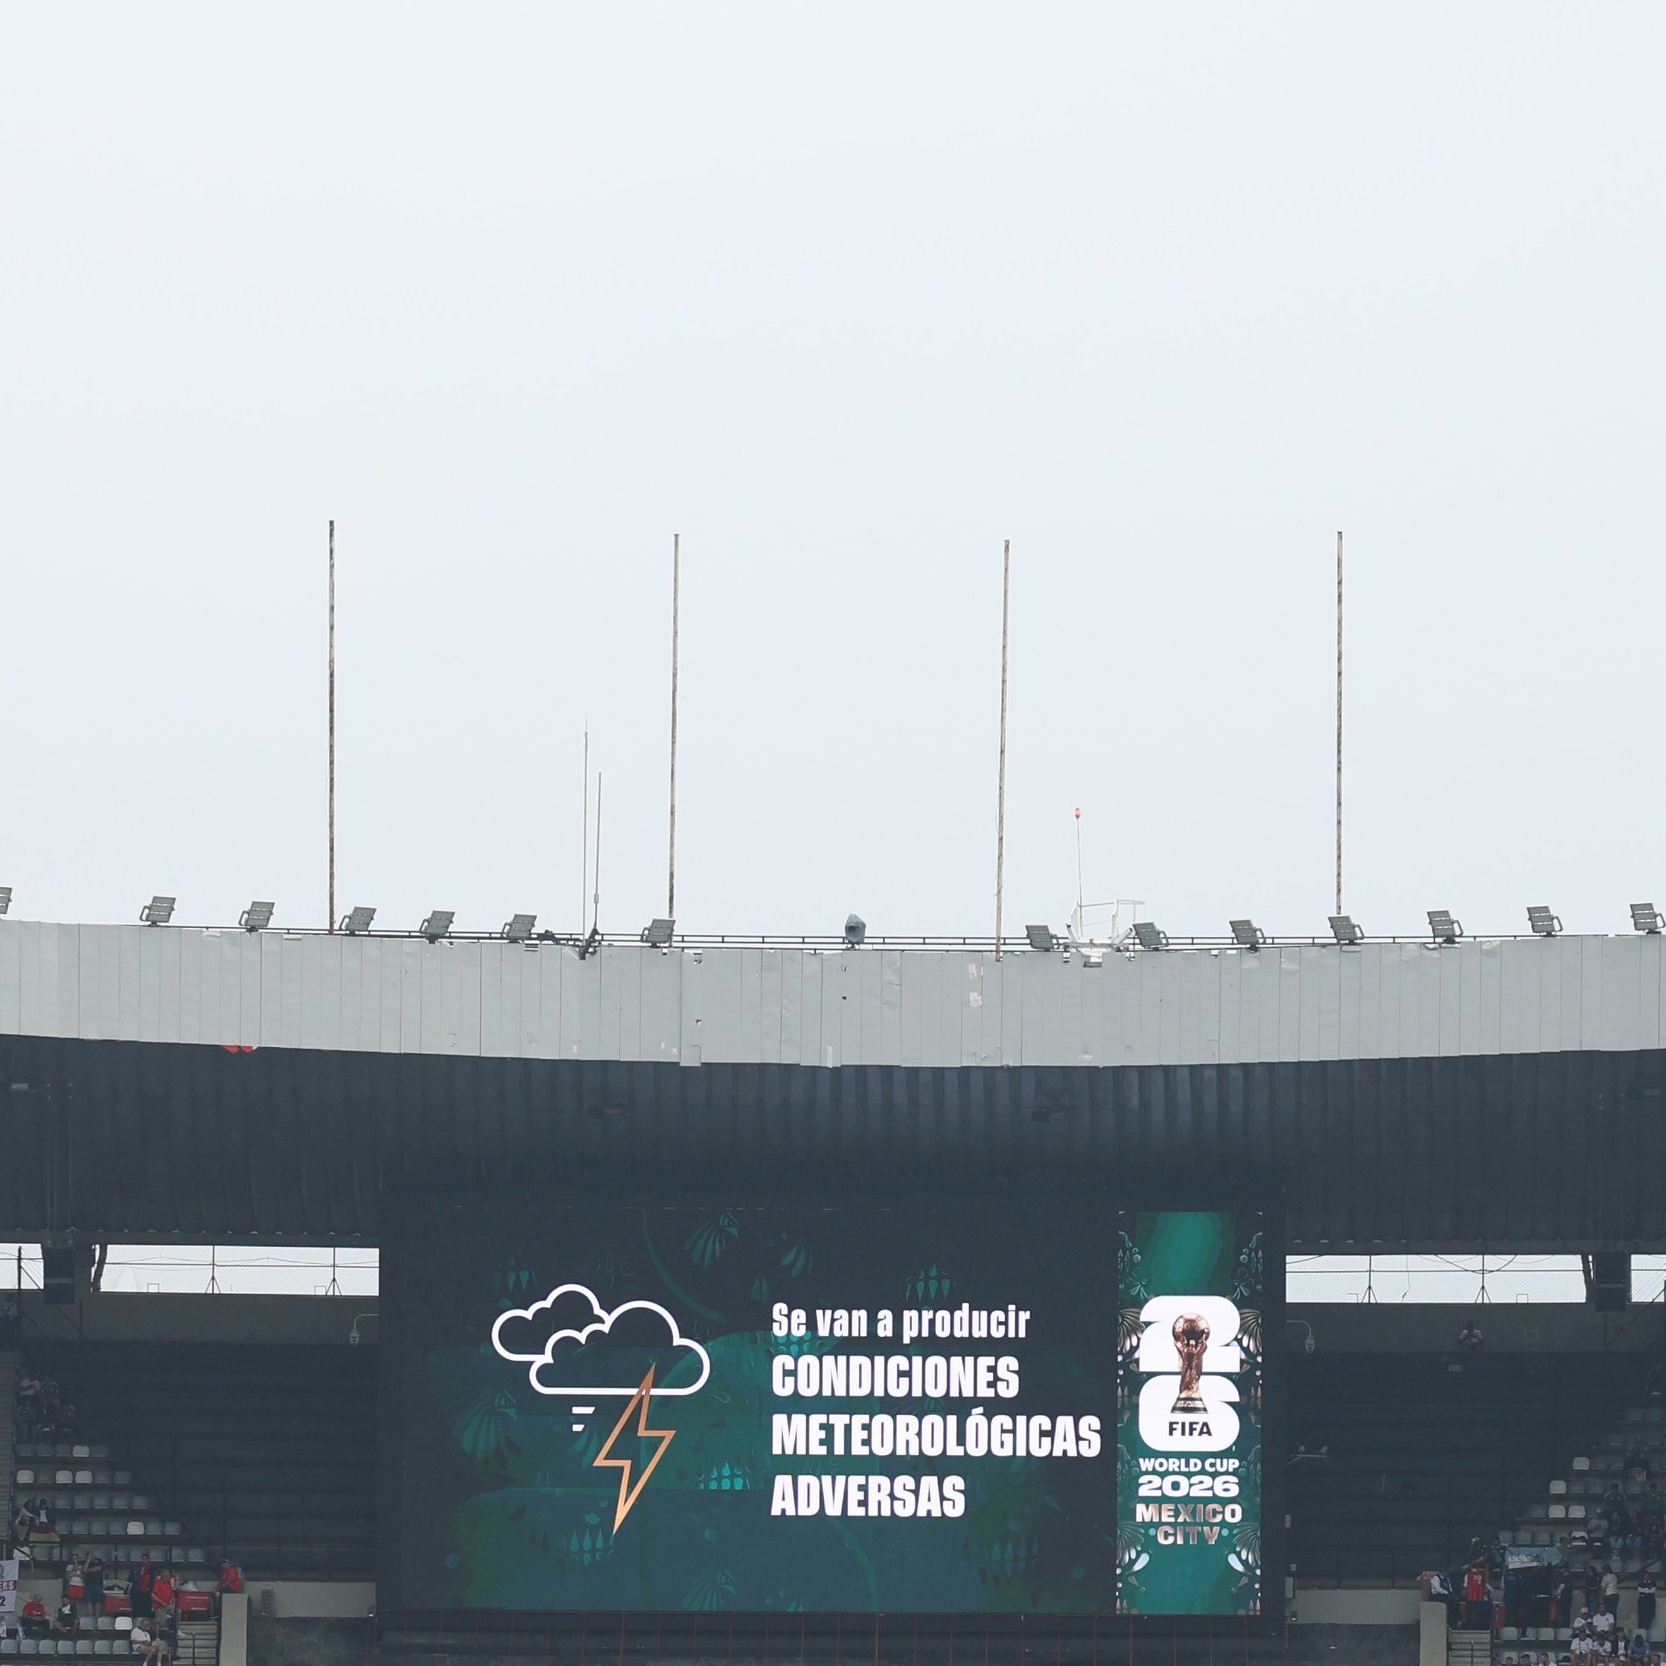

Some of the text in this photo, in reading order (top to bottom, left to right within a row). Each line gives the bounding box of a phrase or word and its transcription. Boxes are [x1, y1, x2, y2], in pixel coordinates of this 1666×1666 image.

[773, 1303, 1030, 1344] Se van a producir
[773, 1355, 1019, 1398] CONDICIONES
[773, 1407, 1100, 1457] METEOROLÓGICAS
[1168, 1421, 1212, 1436] FIFA
[1139, 1458, 1239, 1472] WORLD CUP
[771, 1475, 965, 1517] ADVERSAS
[1138, 1475, 1239, 1497] 2026
[1136, 1504, 1242, 1523] MEXICO
[1157, 1526, 1220, 1545] CITY
